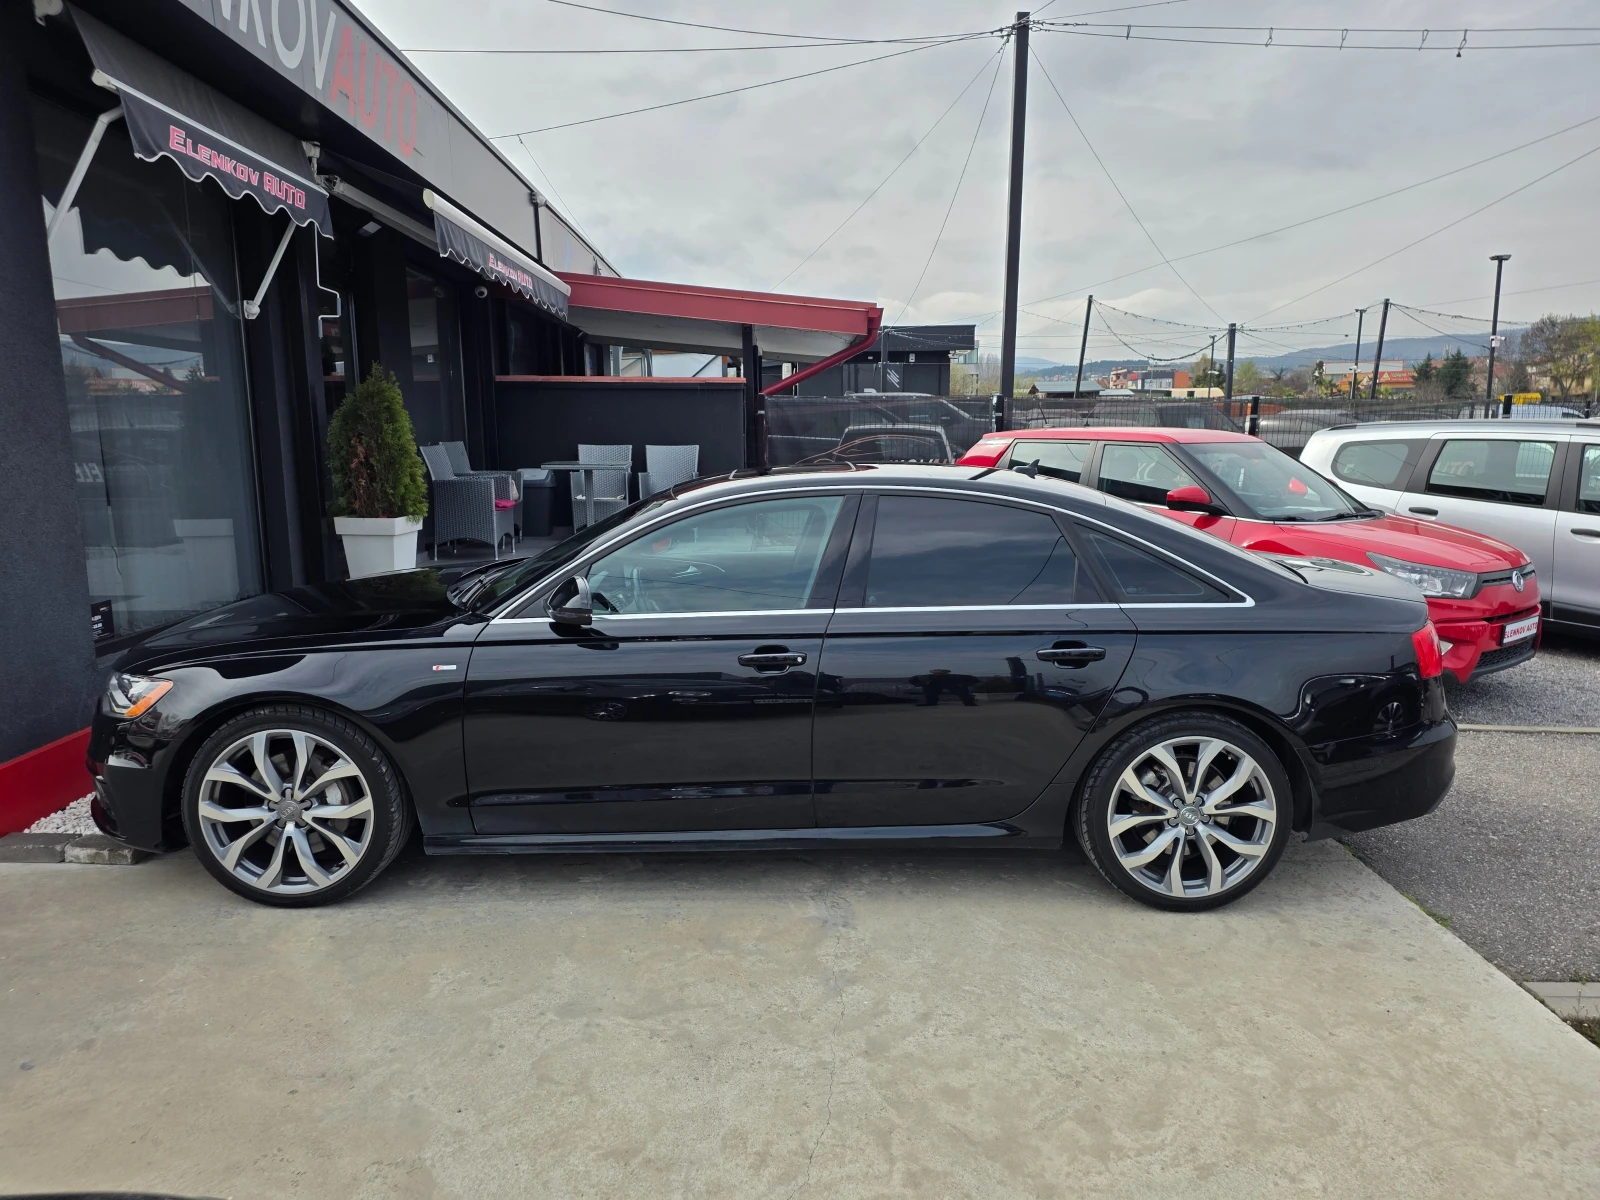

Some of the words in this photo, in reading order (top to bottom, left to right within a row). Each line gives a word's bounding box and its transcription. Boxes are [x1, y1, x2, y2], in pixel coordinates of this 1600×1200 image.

[221, 0, 337, 90] OV
[330, 24, 417, 158] AUTO
[169, 125, 260, 186] ELENKOV
[263, 171, 306, 209] AUTO
